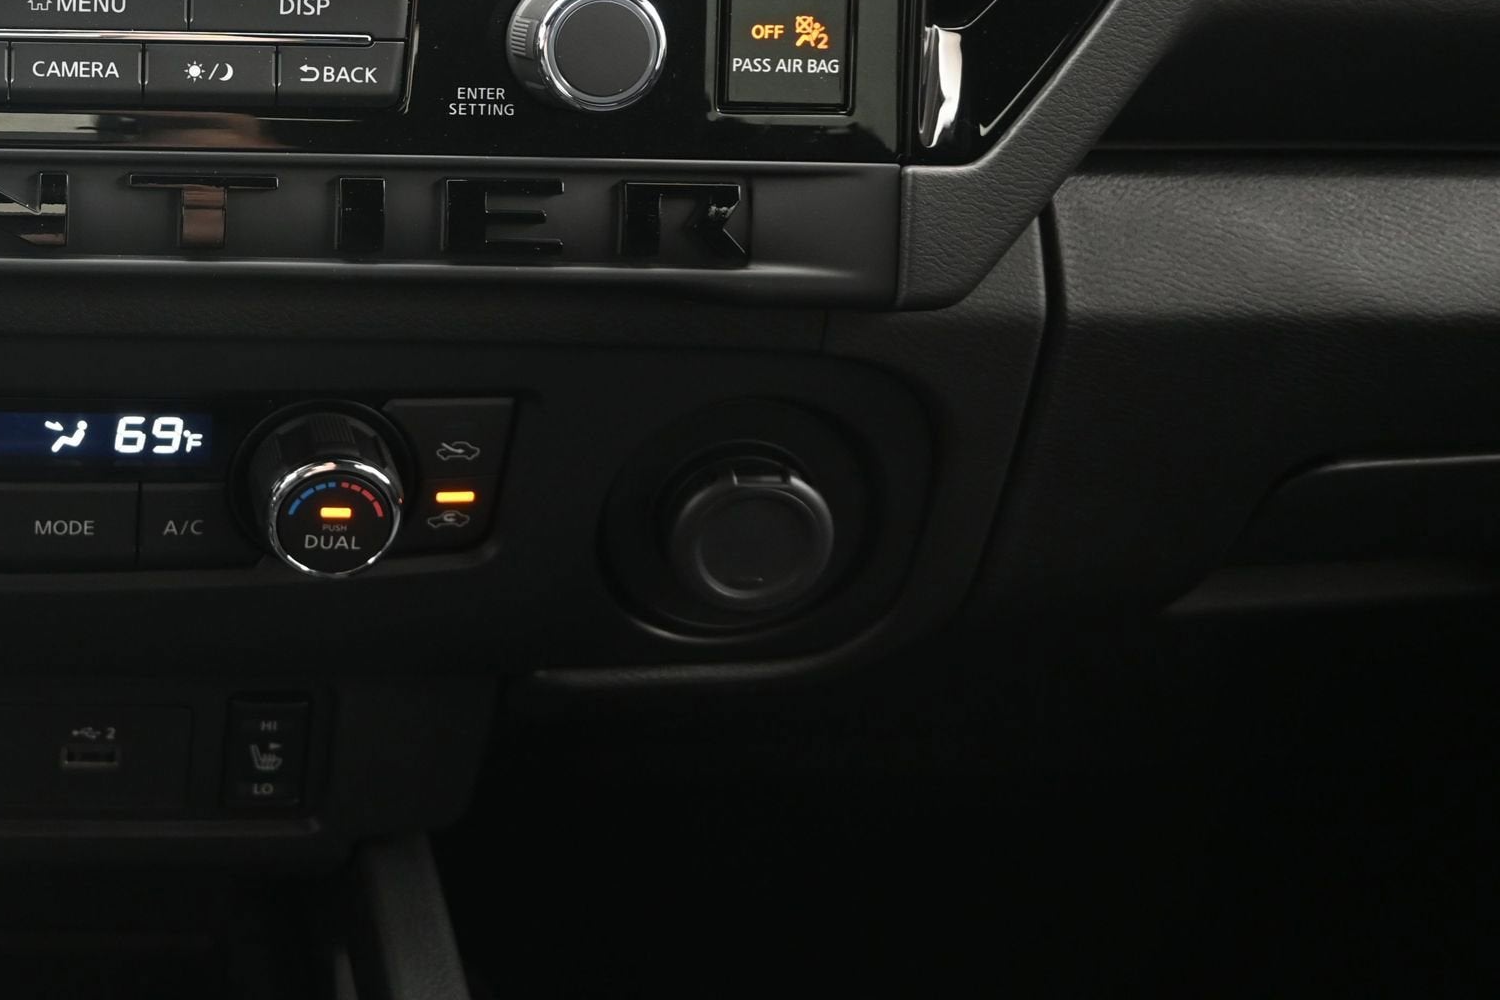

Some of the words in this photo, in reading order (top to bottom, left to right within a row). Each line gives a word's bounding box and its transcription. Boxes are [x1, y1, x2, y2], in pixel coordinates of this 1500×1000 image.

[751, 24, 784, 39] OFF
[32, 60, 120, 79] CAMERA
[732, 57, 772, 73] PASS
[775, 58, 803, 73] AIR
[807, 59, 840, 74] BAG
[322, 65, 378, 84] BACK
[456, 86, 506, 101] ENTER
[448, 101, 515, 117] SETTING
[33, 519, 95, 537] MODE
[162, 518, 204, 538] A/C
[322, 522, 348, 533] PUSH
[304, 533, 362, 552] DUAL
[106, 727, 117, 740] 2
[260, 720, 279, 731] HI
[252, 784, 275, 796] LO
